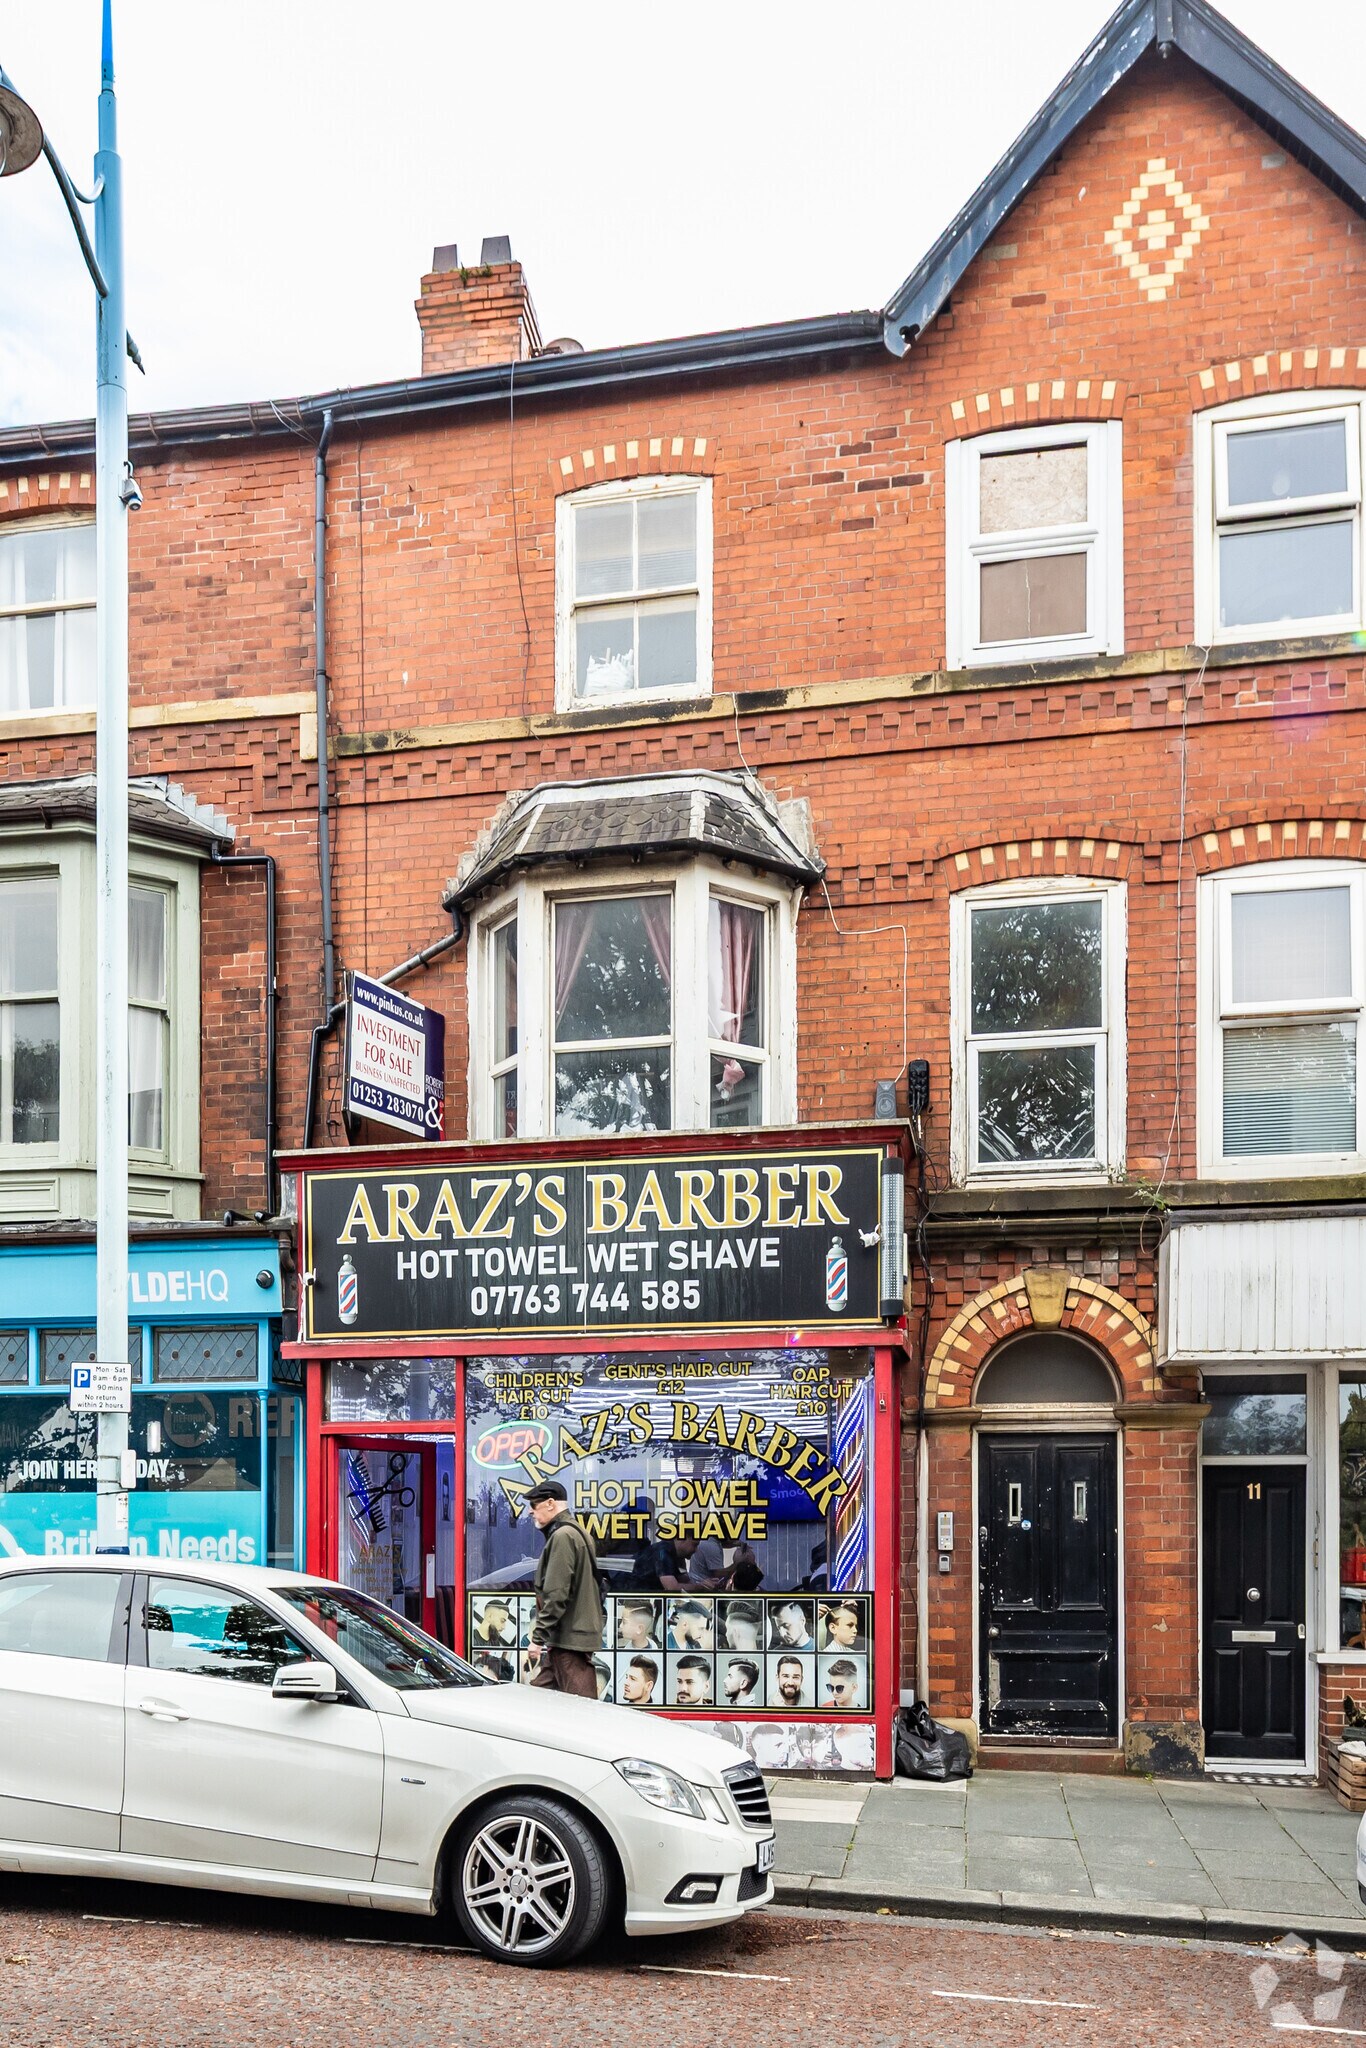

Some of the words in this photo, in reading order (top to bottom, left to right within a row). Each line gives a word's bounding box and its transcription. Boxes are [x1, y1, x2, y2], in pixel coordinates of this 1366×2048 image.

[356, 987, 424, 1027] www.pinkus.co.uk
[357, 1013, 421, 1057] INVESTMENT
[364, 1042, 386, 1066] FOR
[389, 1052, 412, 1077] SALE
[355, 1060, 383, 1081] BUSINESS
[383, 1072, 421, 1095] UNAFFECTED
[352, 1081, 383, 1107] 01253
[386, 1094, 424, 1122] 283070
[337, 1172, 567, 1245] ARAZ'S
[587, 1164, 850, 1234] BARBER
[397, 1249, 459, 1280] HOT
[465, 1245, 578, 1277] TOWEL
[587, 1241, 659, 1273] WET
[668, 1237, 780, 1271] SHAVE
[128, 1269, 228, 1302] LDEHQ
[470, 1284, 561, 1316] 07763
[572, 1281, 629, 1313] 744
[641, 1279, 700, 1310] 585
[95, 1366, 110, 1374] Mon
[114, 1366, 126, 1374] Sat
[484, 1371, 584, 1388] CHILDREN'S
[605, 1363, 667, 1379] GENT'S
[672, 1362, 714, 1378] HAIR
[717, 1361, 753, 1376] CUT
[792, 1367, 831, 1382] OAP
[495, 1388, 535, 1404] HAIR
[539, 1388, 573, 1403] CUT
[657, 1380, 685, 1395] £12
[769, 1384, 813, 1399] HAIR
[816, 1384, 853, 1399] CUT
[520, 1404, 549, 1420] £10
[796, 1401, 827, 1416] £10
[476, 1428, 545, 1463] OPEN
[498, 1402, 654, 1519] ARAZ'S
[669, 1400, 849, 1516] BARBER
[18, 1460, 58, 1480] JOIN
[63, 1460, 97, 1479] HER
[136, 1459, 169, 1478] DAY
[575, 1479, 644, 1508] HOT
[650, 1479, 769, 1508] TOWEL
[769, 1488, 806, 1499] Smoo
[1247, 1483, 1261, 1500] 11
[577, 1511, 650, 1541] WET
[656, 1511, 768, 1541] SHAVE
[45, 1529, 147, 1556] Britn
[159, 1529, 255, 1562] Needs
